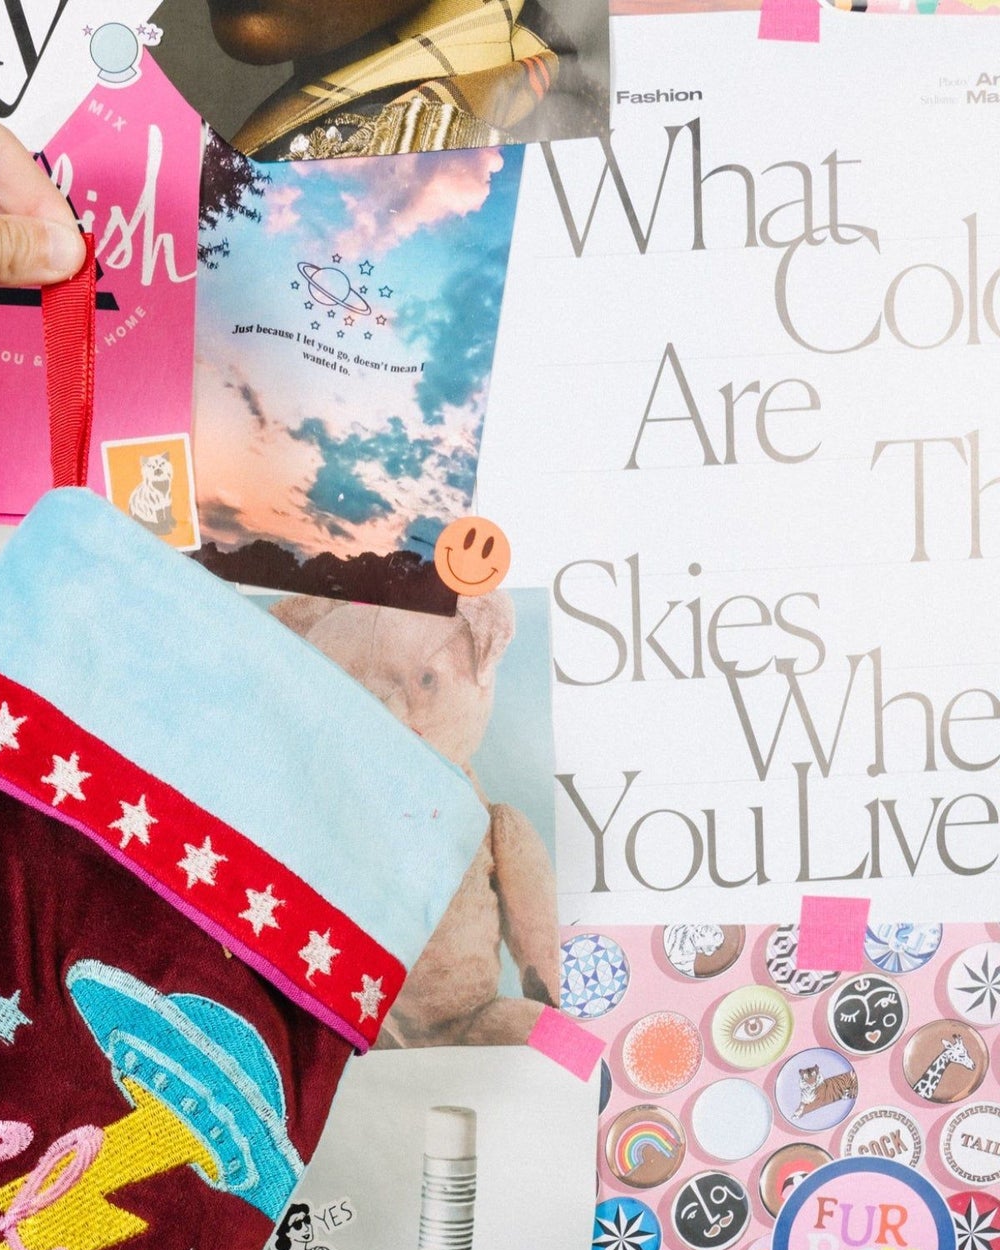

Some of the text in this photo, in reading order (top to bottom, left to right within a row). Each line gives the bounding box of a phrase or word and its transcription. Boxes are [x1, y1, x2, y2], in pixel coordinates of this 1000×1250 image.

[88, 100, 127, 131] MIX
[616, 87, 703, 105] Fashion
[540, 116, 862, 258] What
[775, 212, 1000, 353] Col
[104, 305, 147, 346] HOME
[232, 324, 425, 373] Just because I let you go, doesn't mean I
[303, 352, 351, 377] wanted to.
[624, 342, 822, 470] Are
[553, 553, 826, 686] Skies
[553, 762, 999, 893] You Live
[314, 1201, 353, 1230] YES
[814, 1197, 908, 1247] FUR
